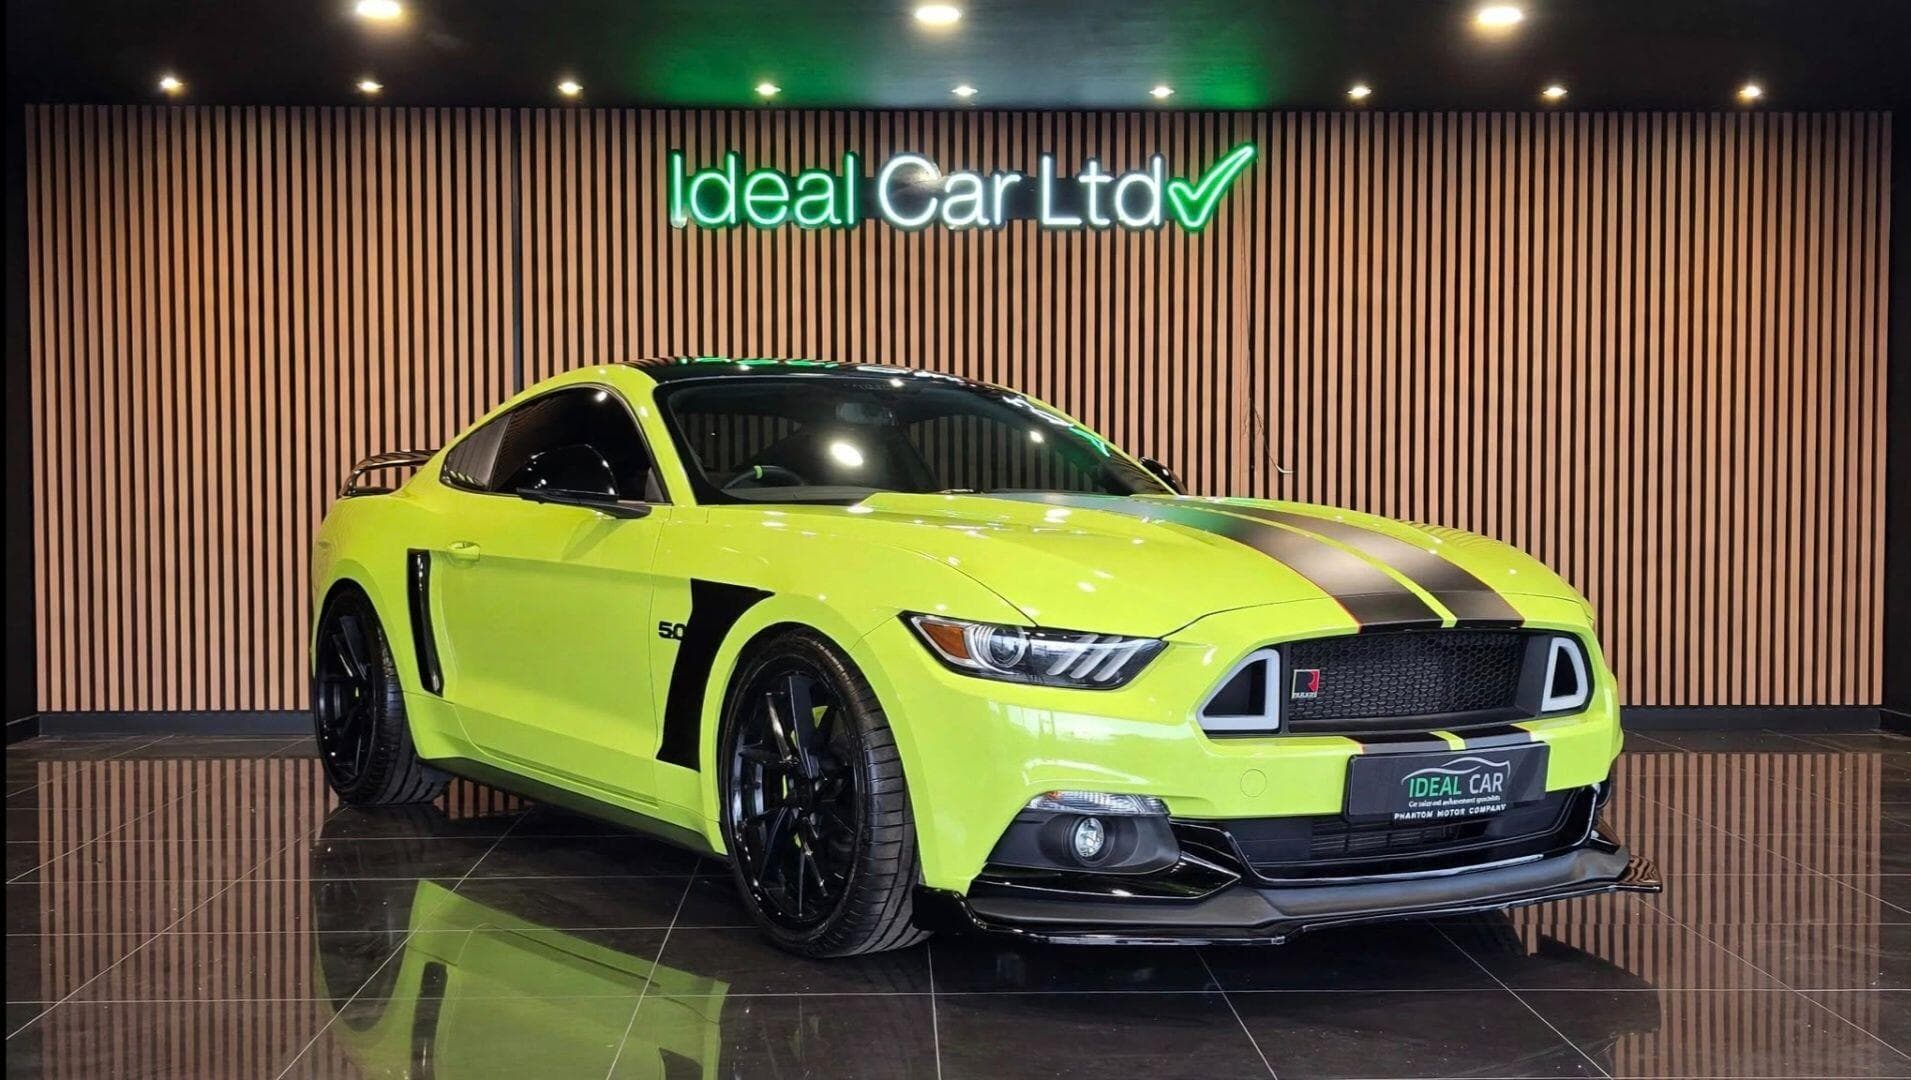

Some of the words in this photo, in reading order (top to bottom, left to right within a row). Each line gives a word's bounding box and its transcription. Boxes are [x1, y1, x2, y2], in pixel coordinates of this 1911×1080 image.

[671, 151, 858, 226] Ideal
[878, 153, 1021, 227] Car
[1042, 154, 1163, 227] Ltd
[1408, 776, 1462, 798] IDEAL
[1469, 773, 1504, 795] CAR
[1394, 810, 1433, 820] PHANTOM
[1437, 807, 1466, 818] MOTOR
[1468, 803, 1507, 815] COMPANY
